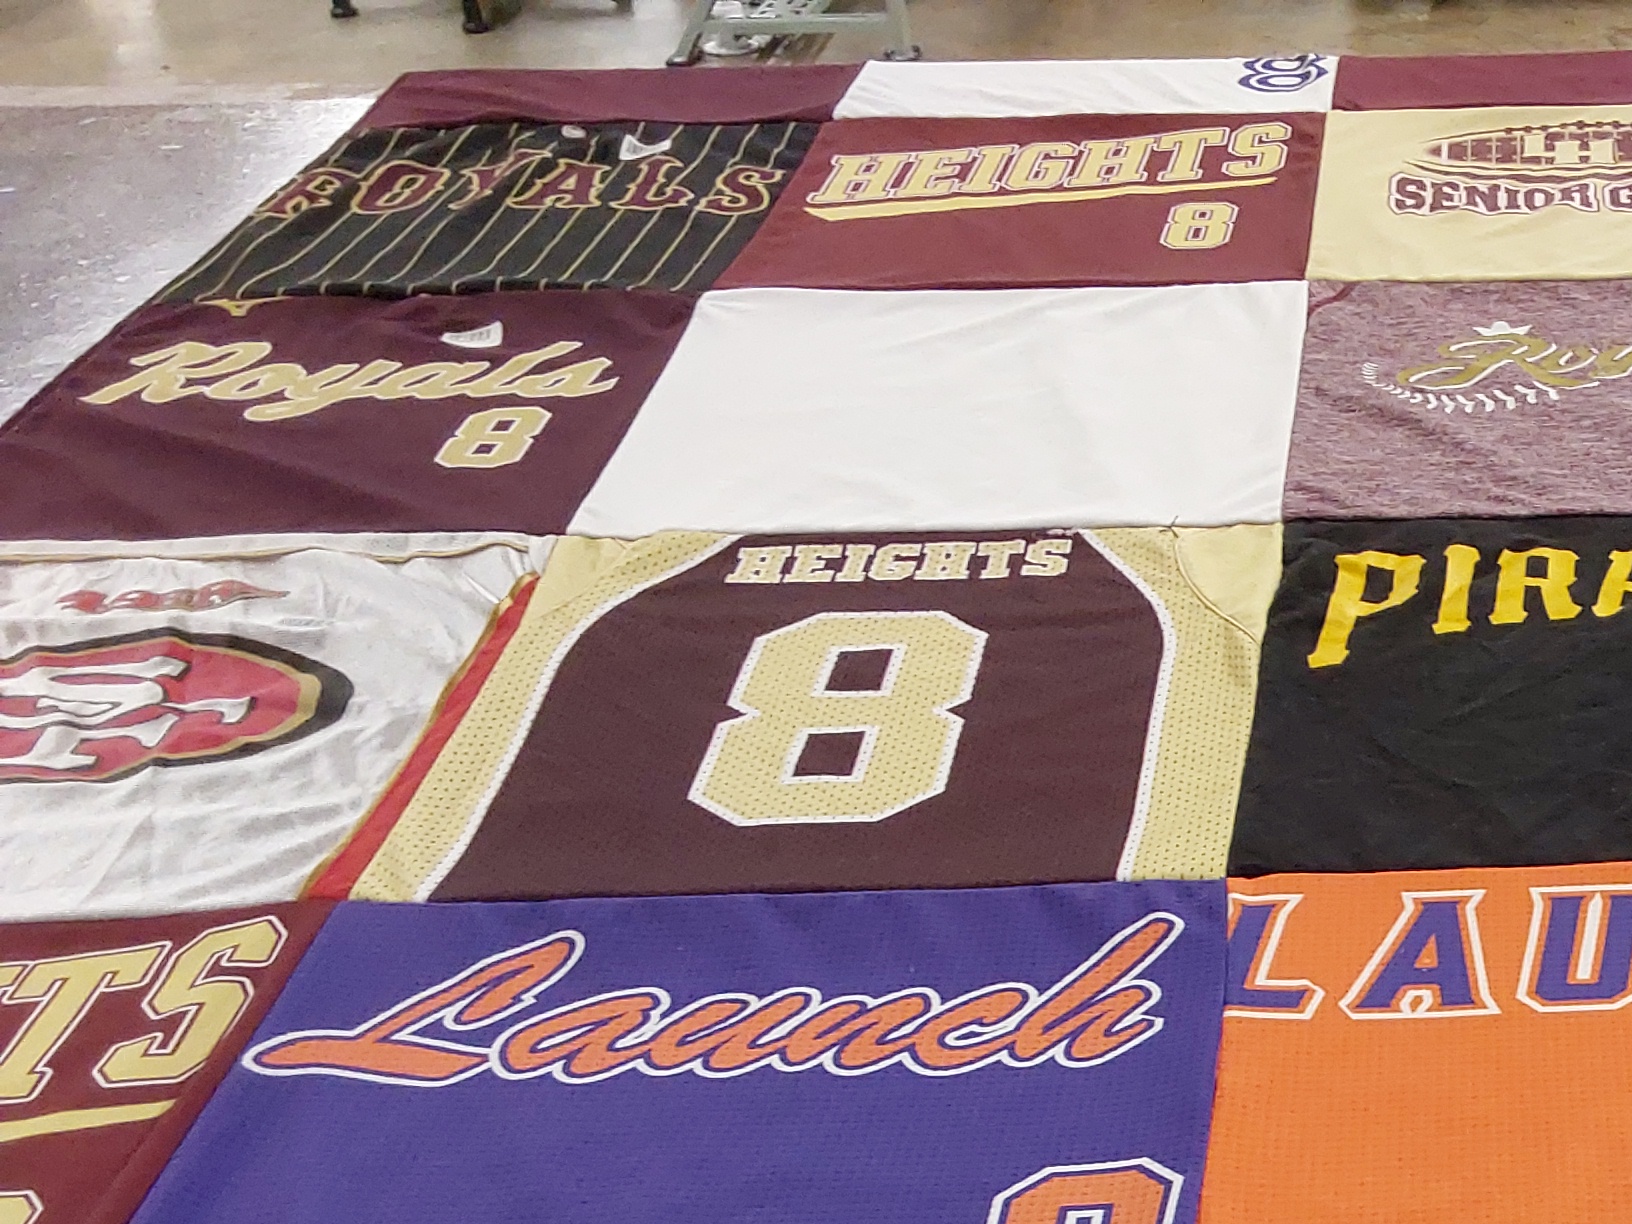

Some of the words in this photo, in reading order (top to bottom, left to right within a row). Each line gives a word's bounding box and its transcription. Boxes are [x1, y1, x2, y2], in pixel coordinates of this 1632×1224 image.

[253, 148, 786, 220] ROYALS
[806, 121, 1293, 204] HEIGHTS
[1389, 172, 1600, 215] SENIOR
[1160, 202, 1238, 250] 8
[80, 340, 621, 423] Royals
[434, 406, 553, 469] 8
[724, 539, 1072, 584] HEIGHTS
[687, 610, 989, 827] 8
[242, 911, 1185, 1088] Launch
